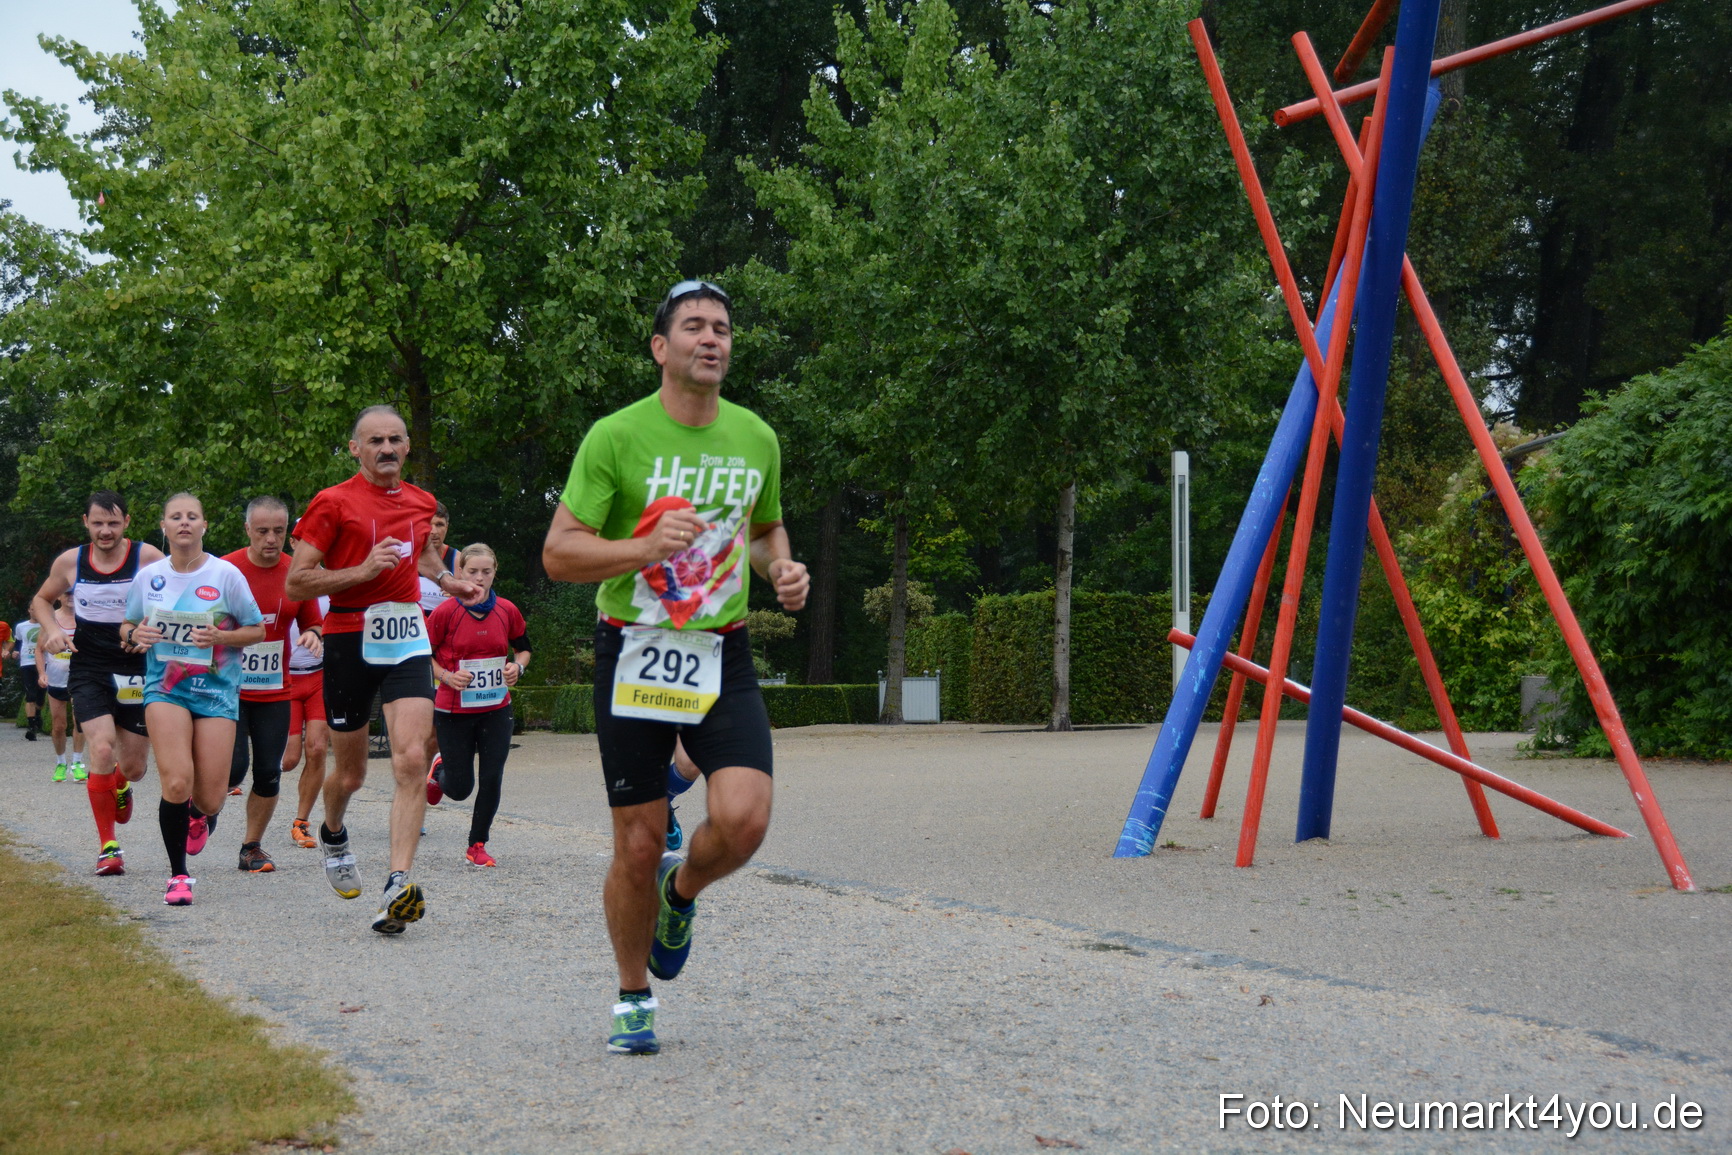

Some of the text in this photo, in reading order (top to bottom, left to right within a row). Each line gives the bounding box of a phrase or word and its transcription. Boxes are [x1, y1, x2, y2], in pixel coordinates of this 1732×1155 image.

[727, 457, 746, 467] 2016
[646, 455, 762, 508] HELFER
[156, 621, 207, 643] 272
[371, 615, 420, 640] 3005
[173, 646, 189, 655] Lisa
[638, 646, 701, 687] 292
[243, 675, 270, 684] Jochen
[467, 668, 503, 689] 2519
[633, 689, 700, 710] Ferdinand
